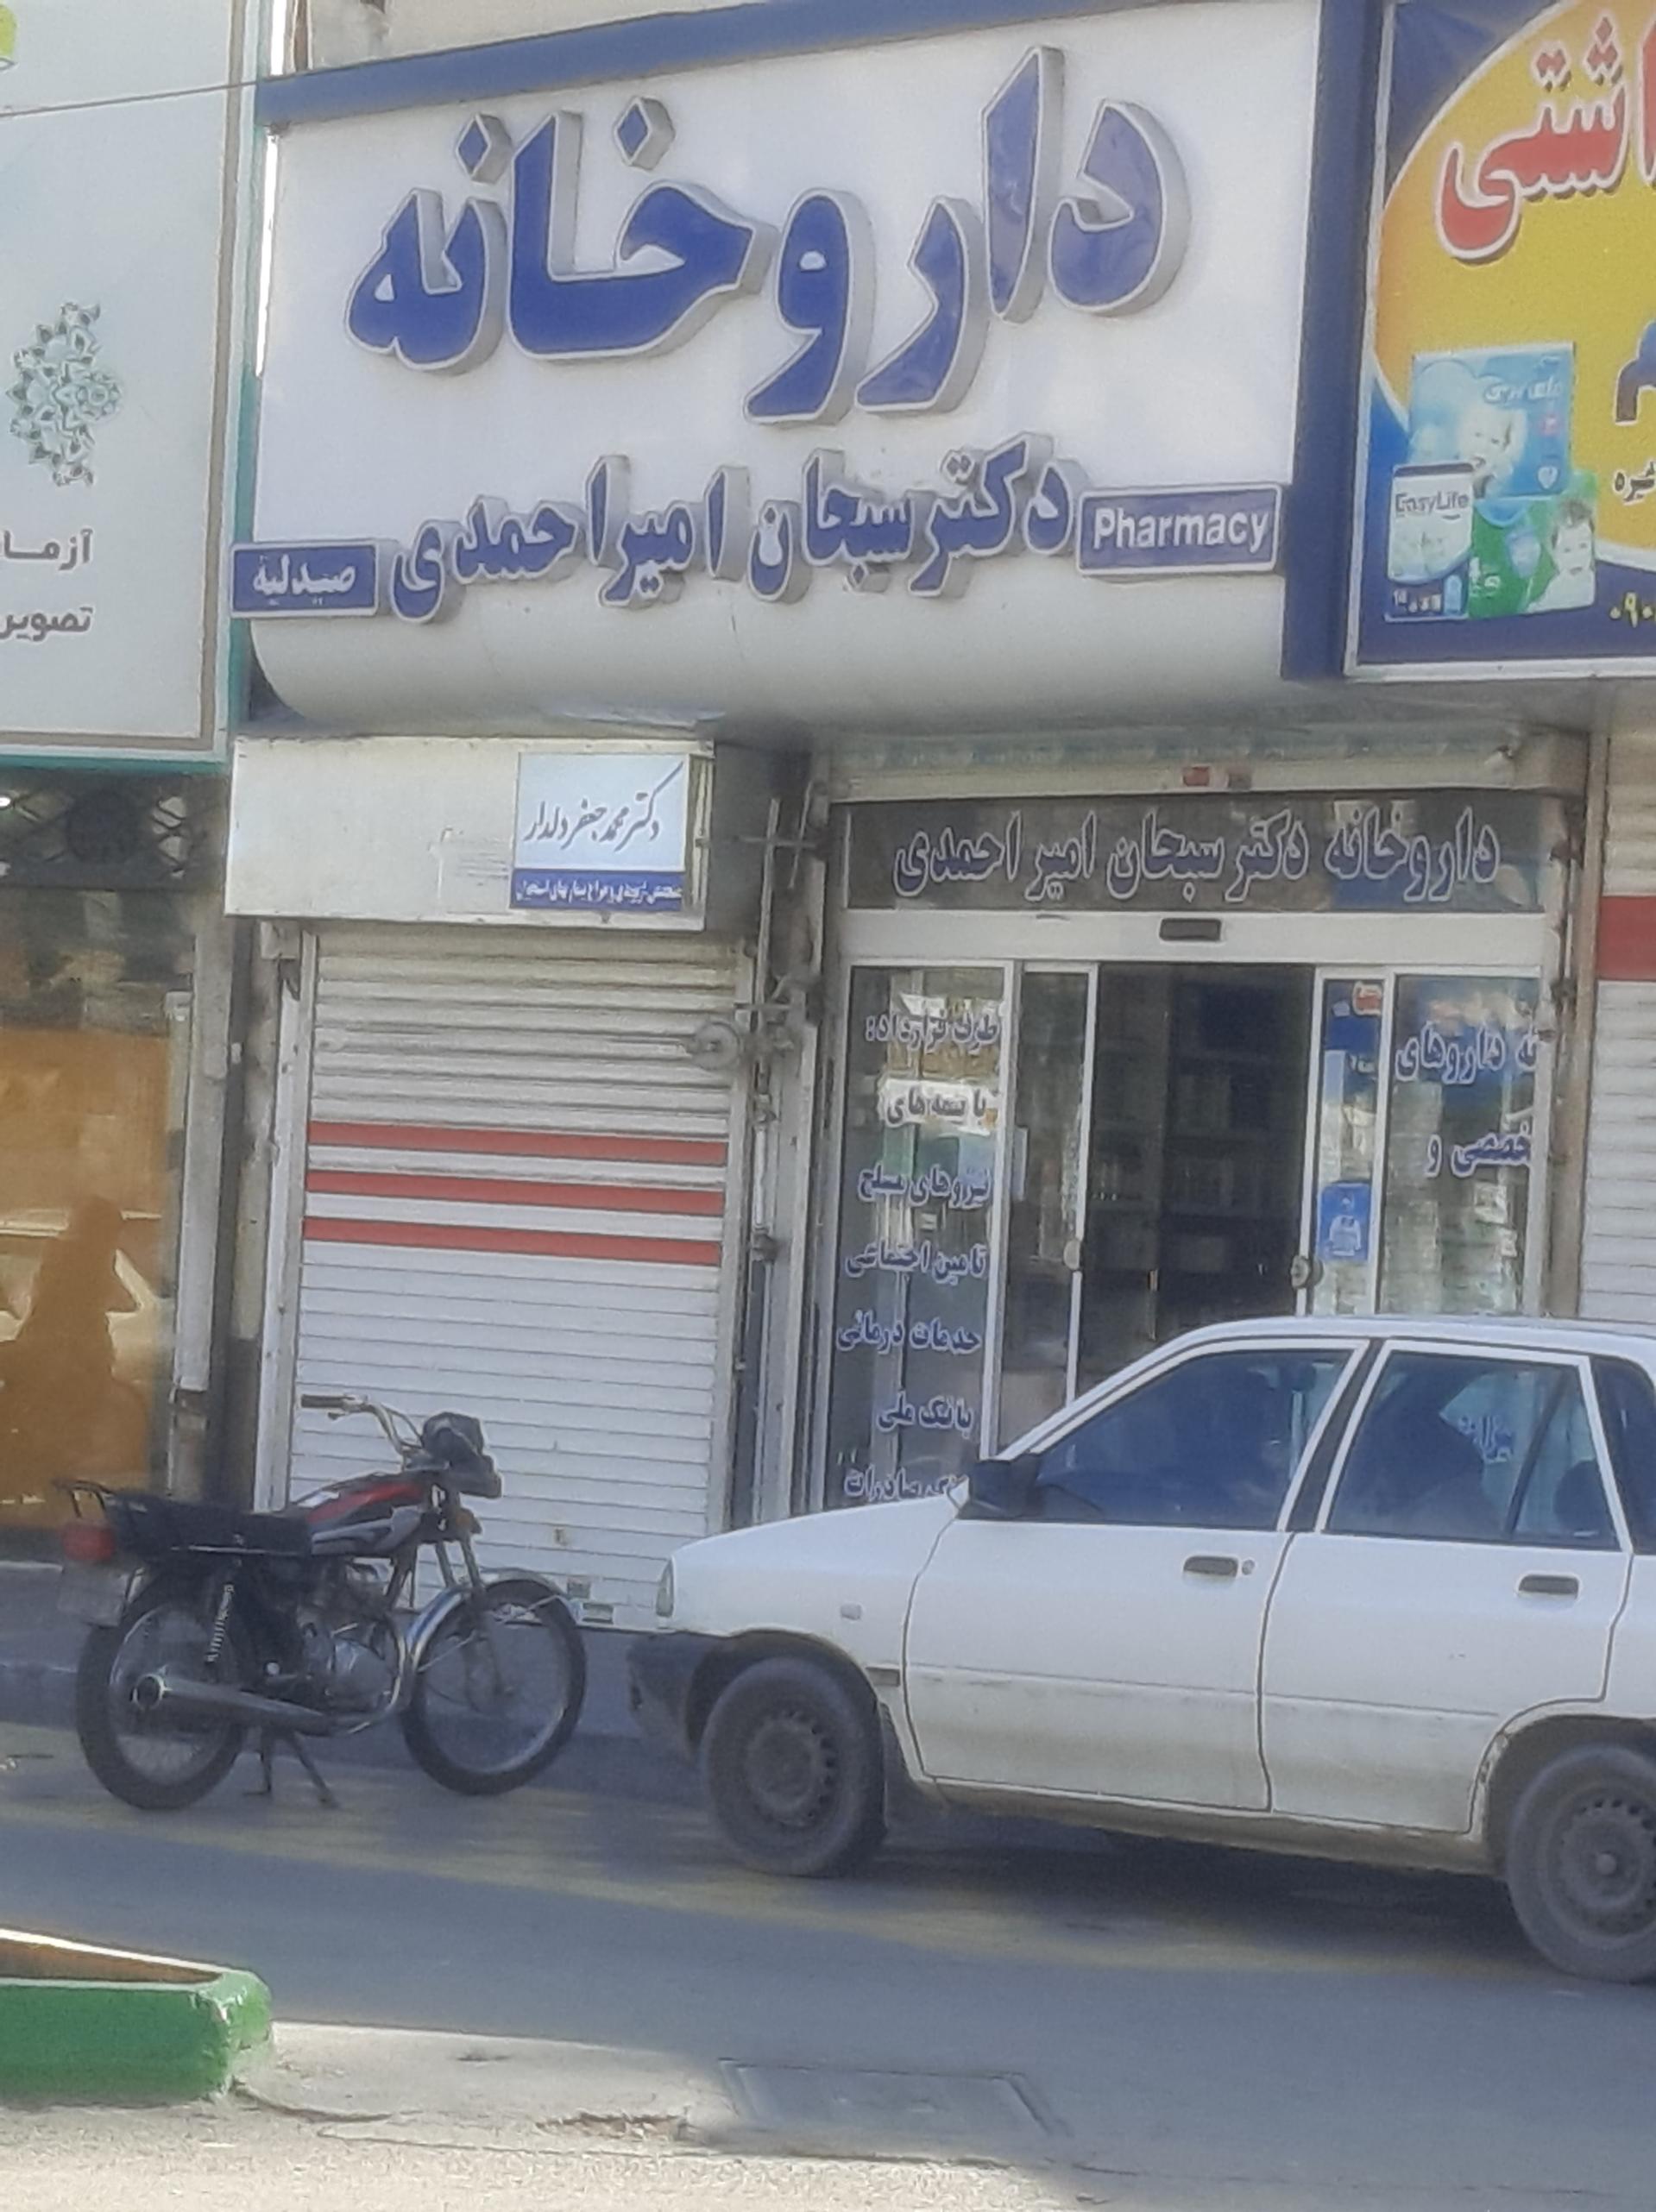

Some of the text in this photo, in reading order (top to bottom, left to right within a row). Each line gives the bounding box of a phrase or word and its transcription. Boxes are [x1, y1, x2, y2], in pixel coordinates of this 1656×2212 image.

[347, 47, 1181, 424] داروخانه
[748, 449, 916, 601] سبحان
[910, 433, 1074, 598] دکتر
[1092, 506, 1269, 551] Pharmacy
[3, 528, 93, 571] آزما
[1609, 591, 1656, 628] ۰۹۰
[522, 760, 684, 852] دکتر محمد جعفر دلدار
[892, 805, 1501, 902] داروخانه دکتر سبحان امیر احمدی
[952, 1009, 1001, 1055] طرف
[1395, 1021, 1506, 1085] داروهای
[1451, 1121, 1533, 1178] خصصی
[857, 1160, 992, 1210] نیروهای مسلح
[845, 1239, 931, 1278] اجتماعی
[835, 1309, 982, 1354] خدمات درمانی
[878, 1389, 975, 1441] بانک ملی
